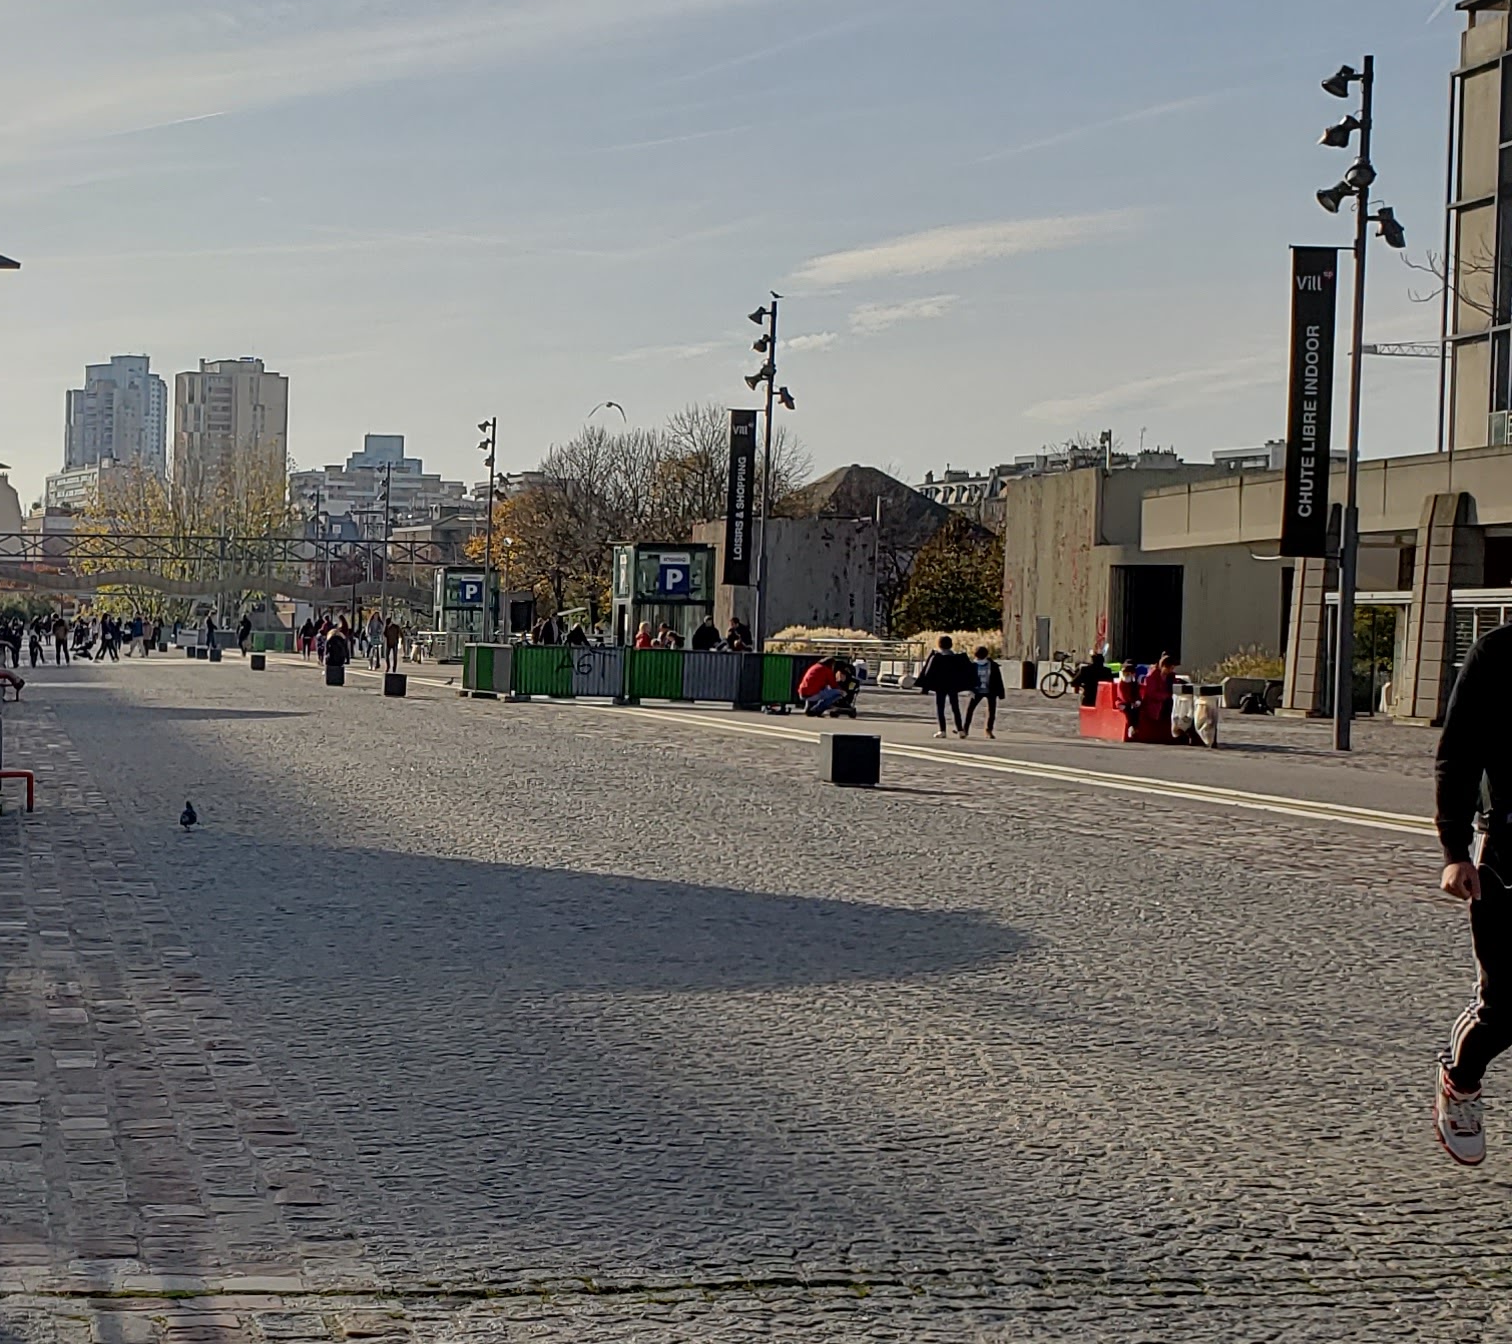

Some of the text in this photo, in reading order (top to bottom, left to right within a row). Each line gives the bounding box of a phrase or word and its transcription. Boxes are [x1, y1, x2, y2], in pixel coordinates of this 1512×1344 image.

[1297, 325, 1321, 518] CHUTE LIBRE INDOOR
[733, 456, 747, 561] LOISIRS & SHOPPING
[465, 584, 478, 600] P
[666, 568, 684, 591] P
